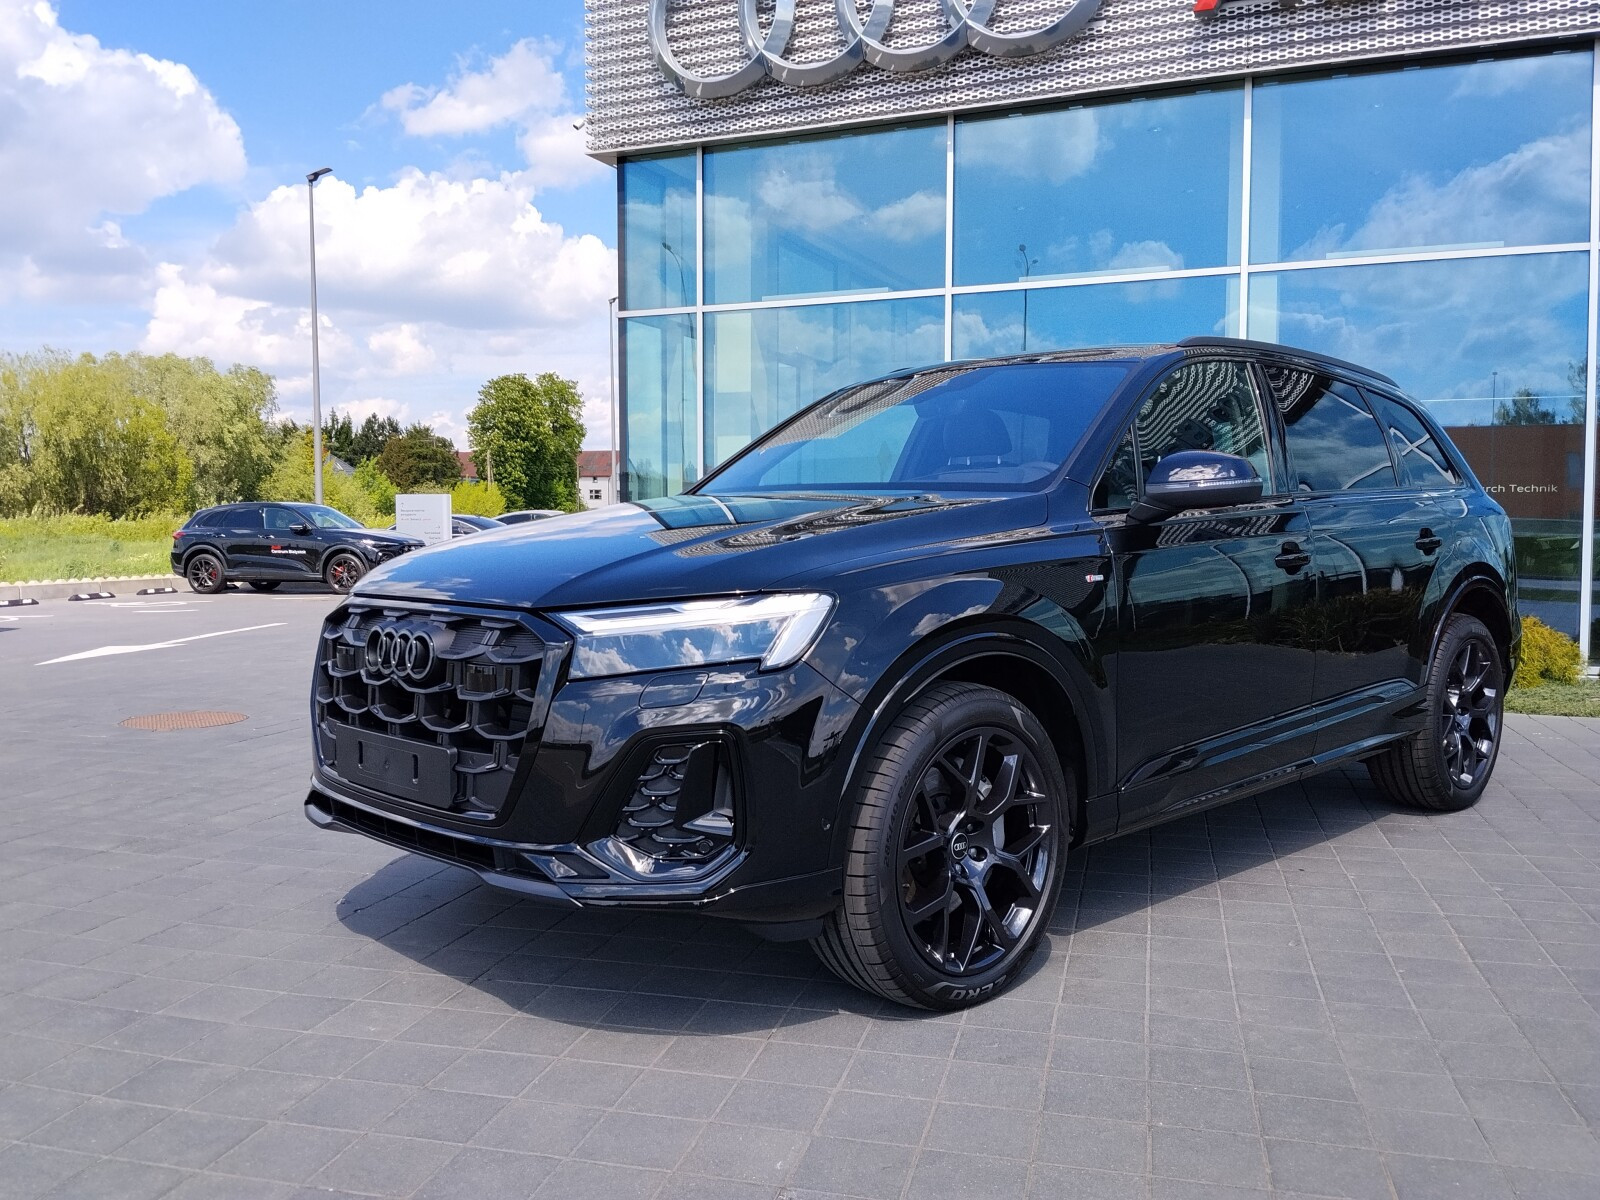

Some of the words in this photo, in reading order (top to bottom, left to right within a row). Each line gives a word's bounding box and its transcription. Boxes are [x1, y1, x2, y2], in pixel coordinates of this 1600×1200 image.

[1482, 484, 1506, 493] rch
[1509, 484, 1558, 493] Technik
[948, 974, 1007, 1000] ZERO
